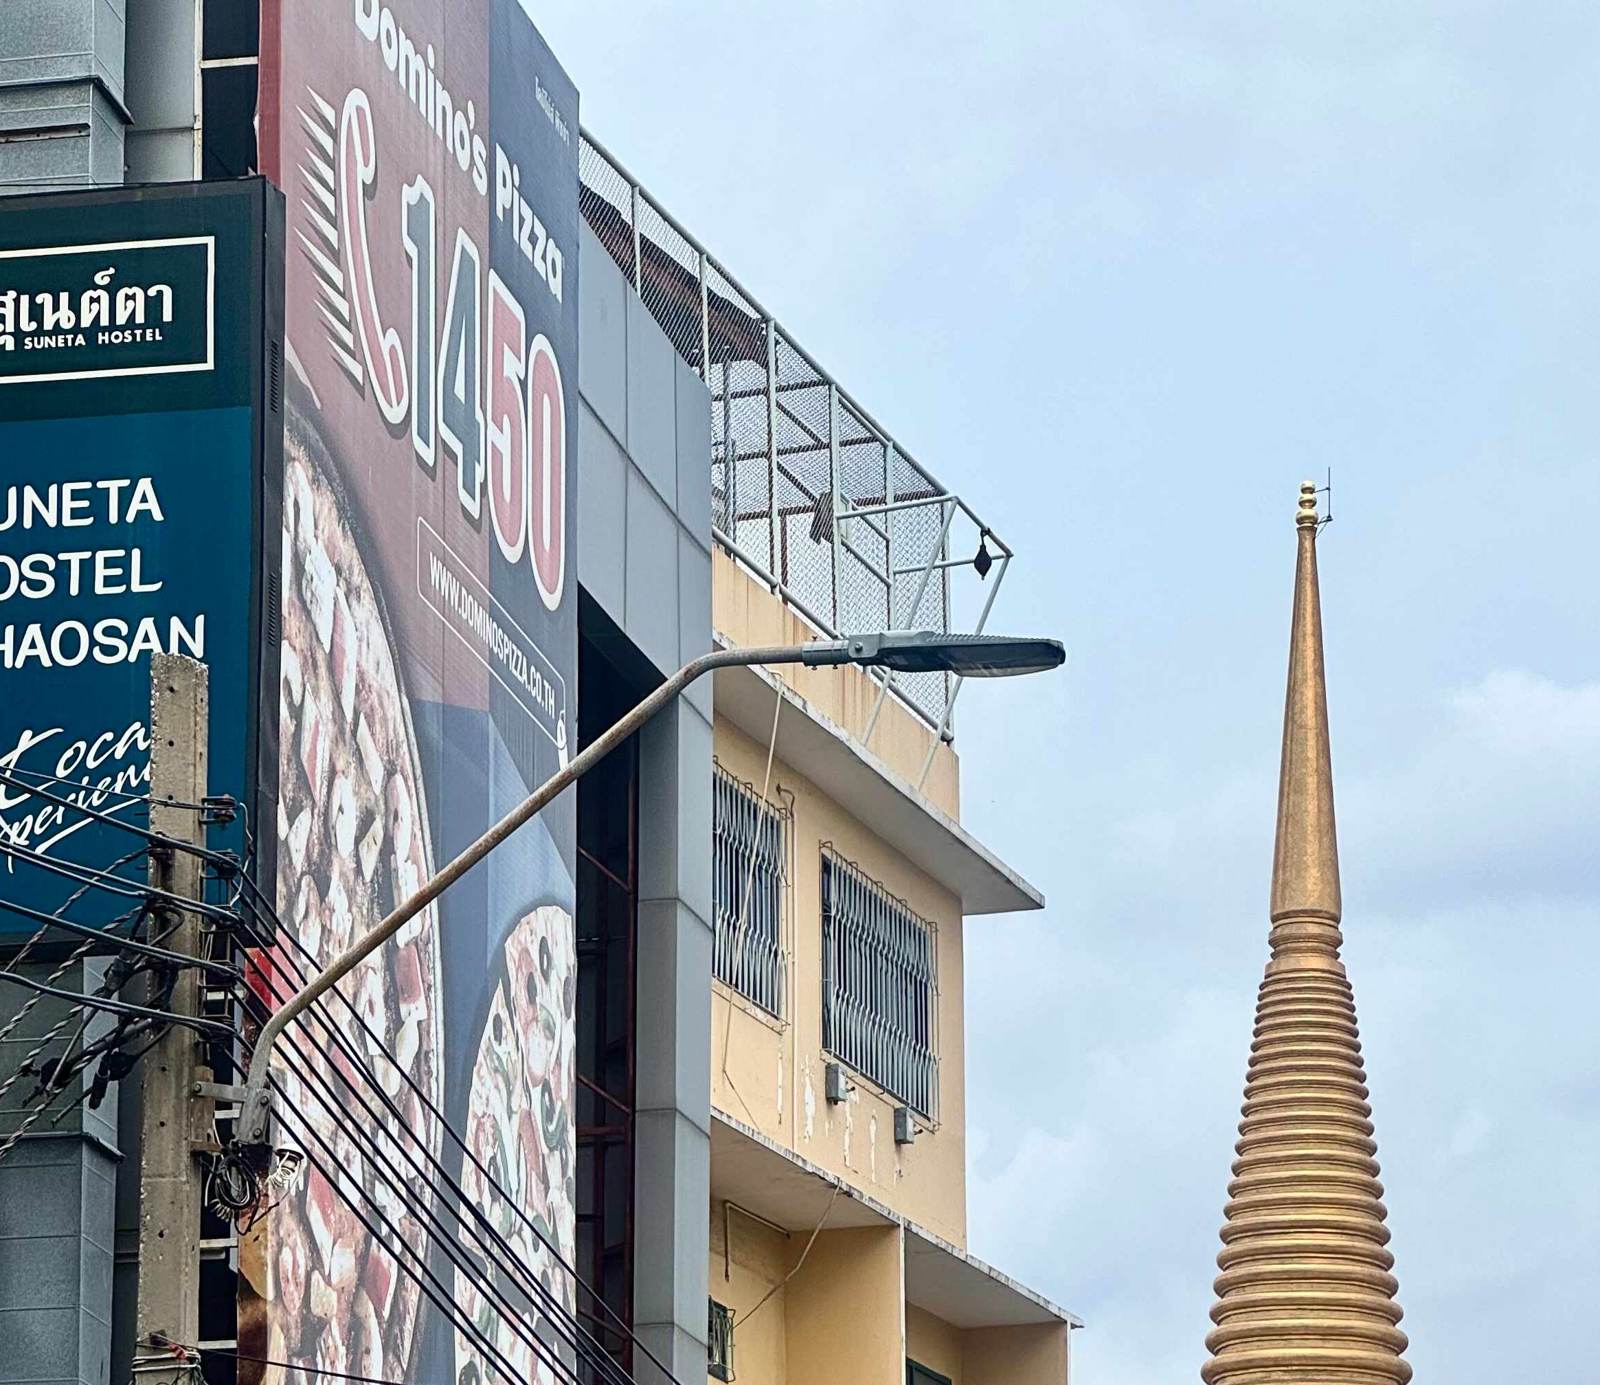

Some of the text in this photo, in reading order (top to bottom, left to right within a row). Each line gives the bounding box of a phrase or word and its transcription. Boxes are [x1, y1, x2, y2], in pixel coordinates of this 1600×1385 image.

[495, 142, 563, 304] Pizza
[23, 328, 163, 350] SUNETA HOSTEL
[402, 174, 567, 612] 1450
[430, 551, 555, 719] WWW.DOMINOSPIZZA.CO.TH
